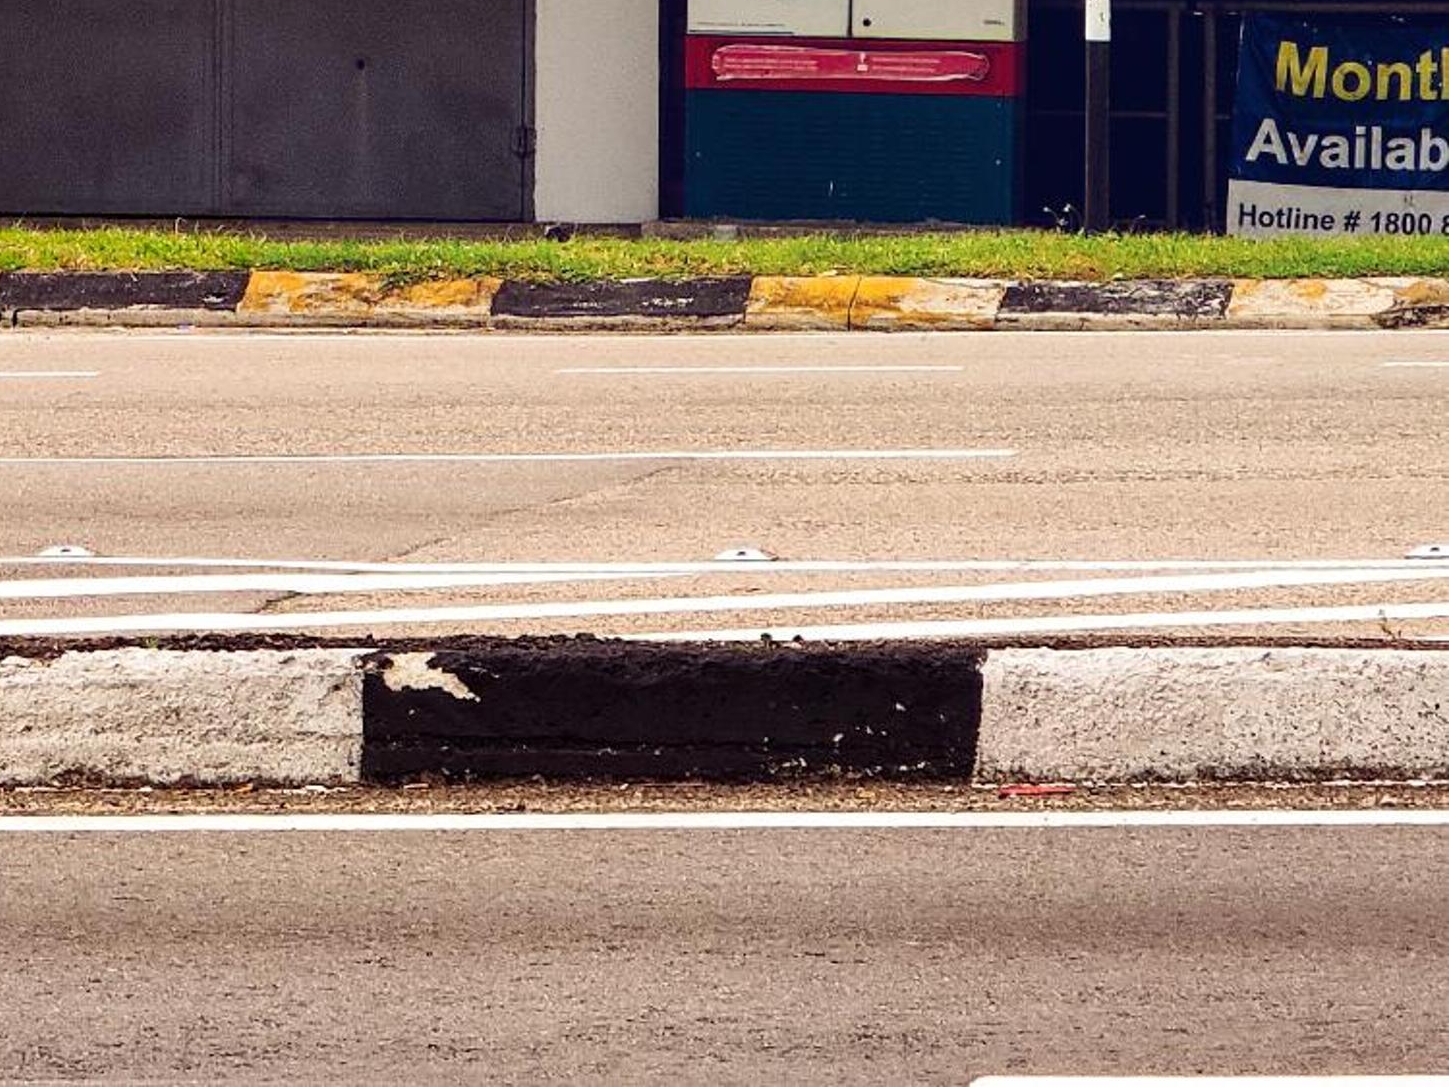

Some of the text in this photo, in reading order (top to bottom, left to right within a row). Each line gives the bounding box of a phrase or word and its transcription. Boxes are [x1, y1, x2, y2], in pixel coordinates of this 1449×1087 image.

[1275, 40, 1449, 102] Mont
[1238, 202, 1336, 231] Hotline
[1343, 211, 1360, 231] #
[1371, 210, 1432, 236] 1800
